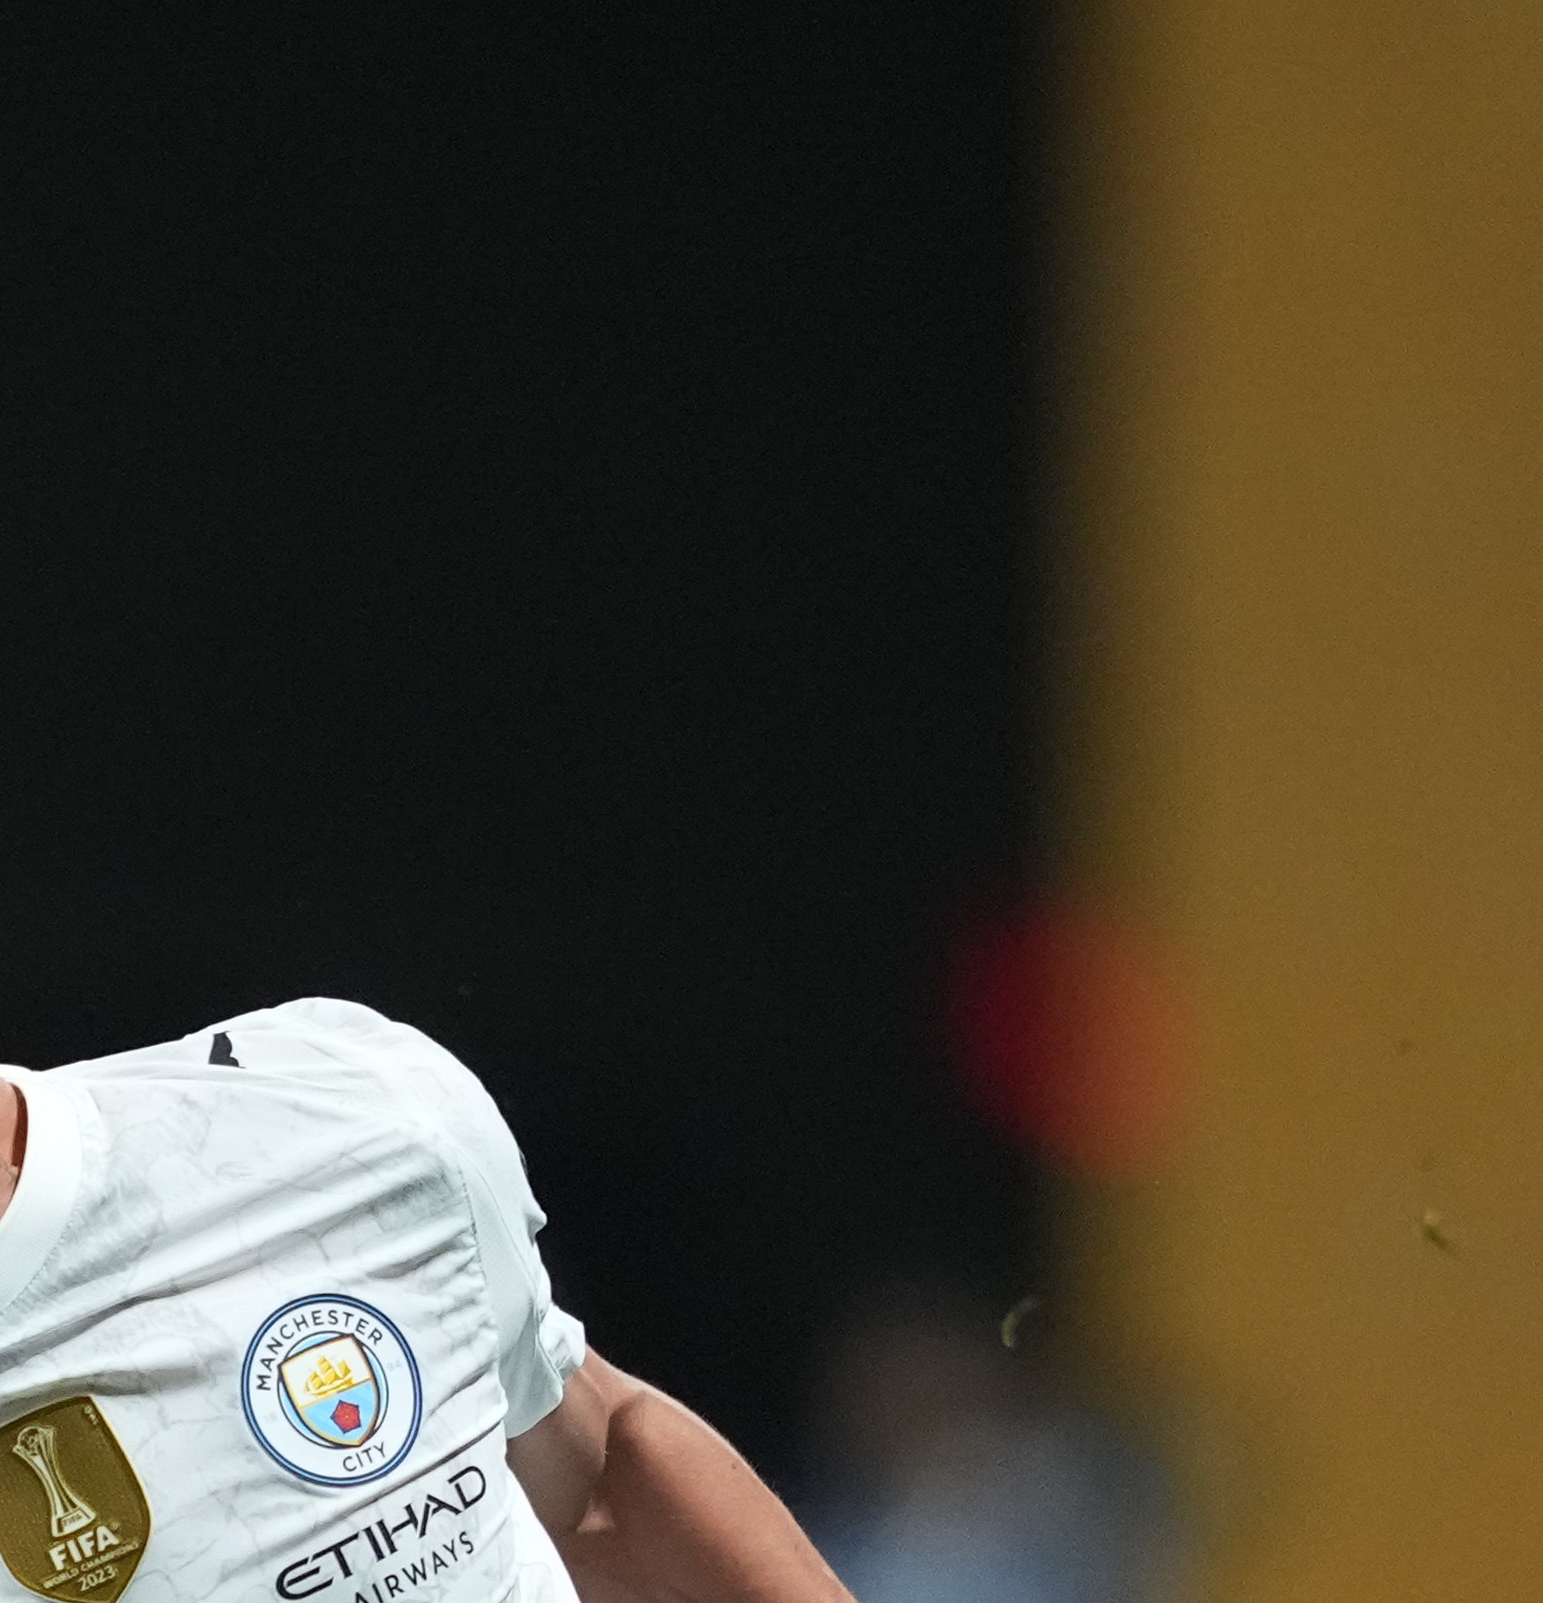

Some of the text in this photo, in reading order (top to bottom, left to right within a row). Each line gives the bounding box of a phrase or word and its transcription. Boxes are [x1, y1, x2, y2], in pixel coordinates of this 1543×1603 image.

[256, 1309, 384, 1391] MANCHESTER
[342, 1442, 387, 1472] CITY
[49, 1525, 120, 1571] FIFA
[275, 1465, 487, 1601] ETIHAD
[43, 1567, 79, 1589] WORLD
[79, 1564, 117, 1592] 2023
